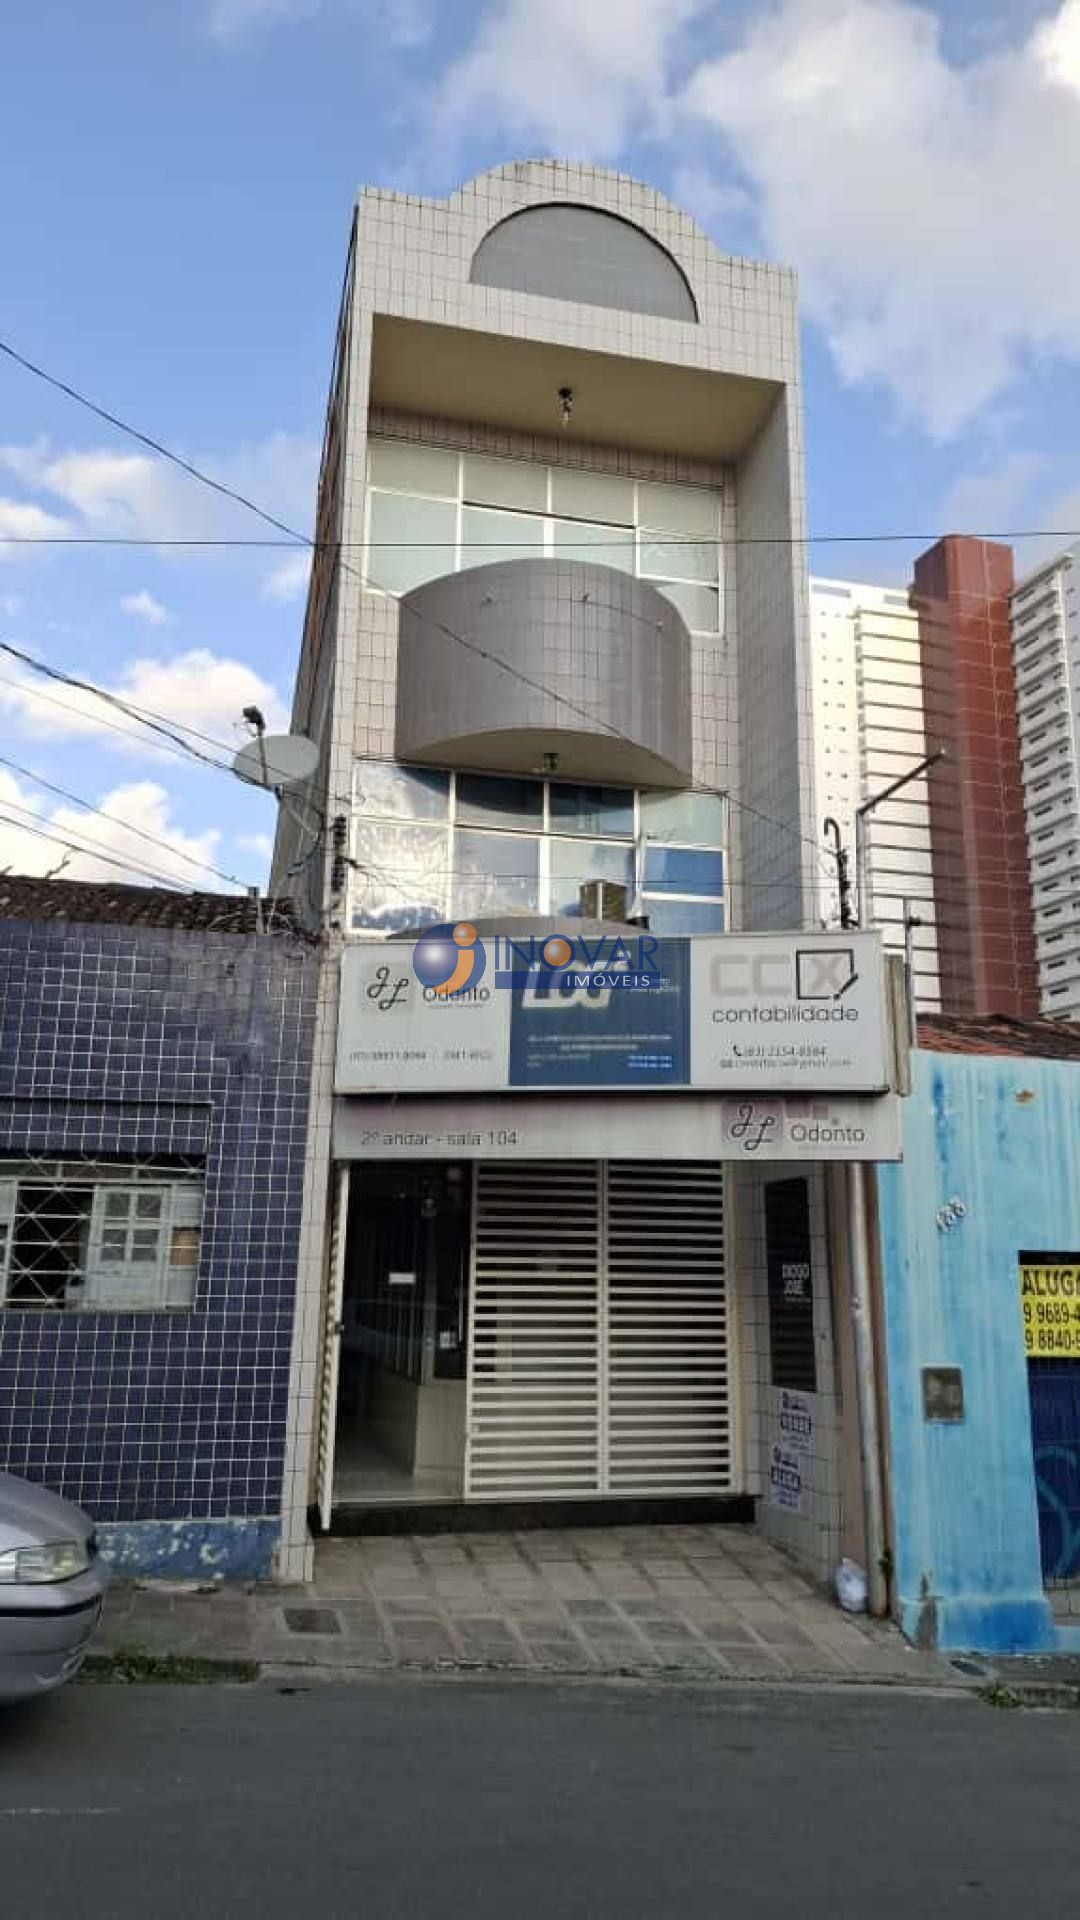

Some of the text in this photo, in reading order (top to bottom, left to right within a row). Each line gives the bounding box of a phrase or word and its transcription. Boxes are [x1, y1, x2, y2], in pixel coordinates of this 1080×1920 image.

[712, 1005, 859, 1023] contabilidade
[382, 1129, 430, 1146] andar
[447, 1129, 482, 1146] sala
[487, 1128, 518, 1145] 104
[790, 1123, 866, 1142] Odonto
[1023, 1302, 1032, 1324] 9
[1025, 1329, 1034, 1350] 9
